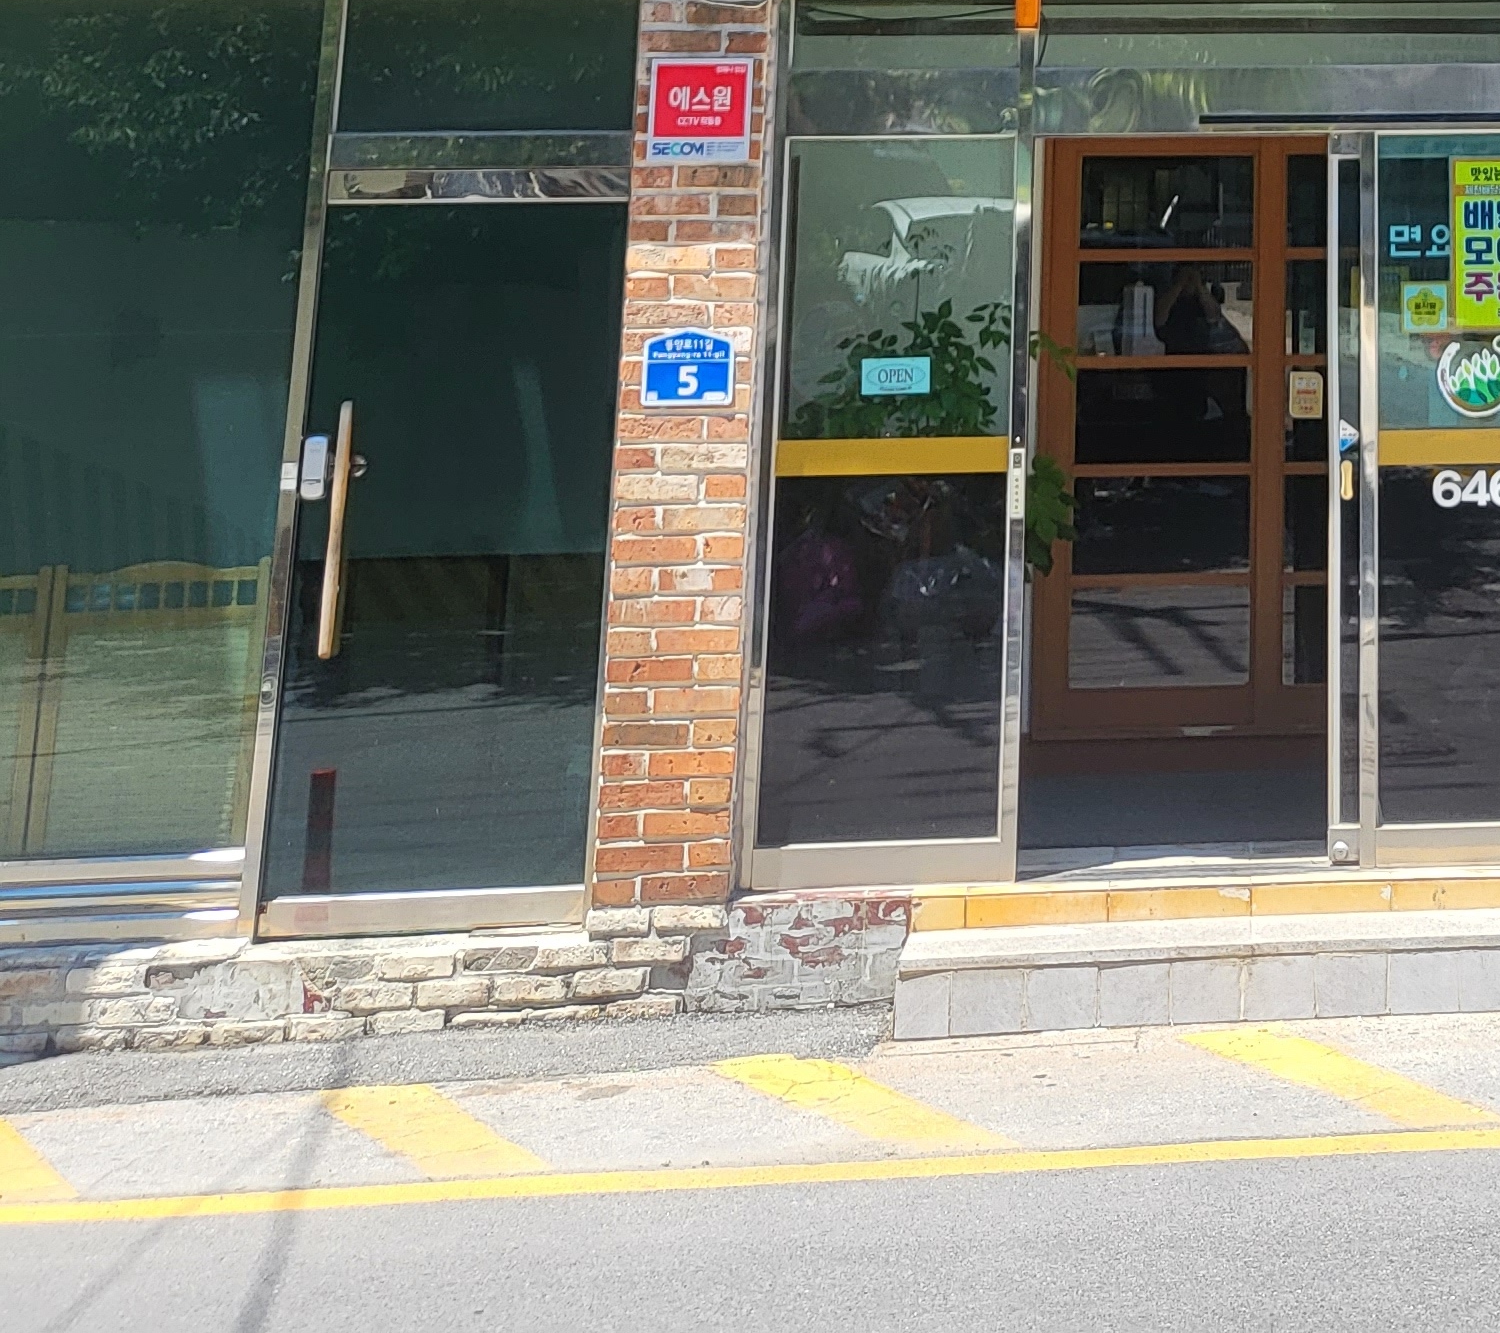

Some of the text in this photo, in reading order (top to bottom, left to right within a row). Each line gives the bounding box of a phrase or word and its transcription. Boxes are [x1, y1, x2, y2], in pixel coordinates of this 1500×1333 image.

[668, 85, 732, 112] 에스원
[651, 142, 705, 156] SECOM
[677, 365, 699, 396] 5
[877, 368, 914, 383] OPEN
